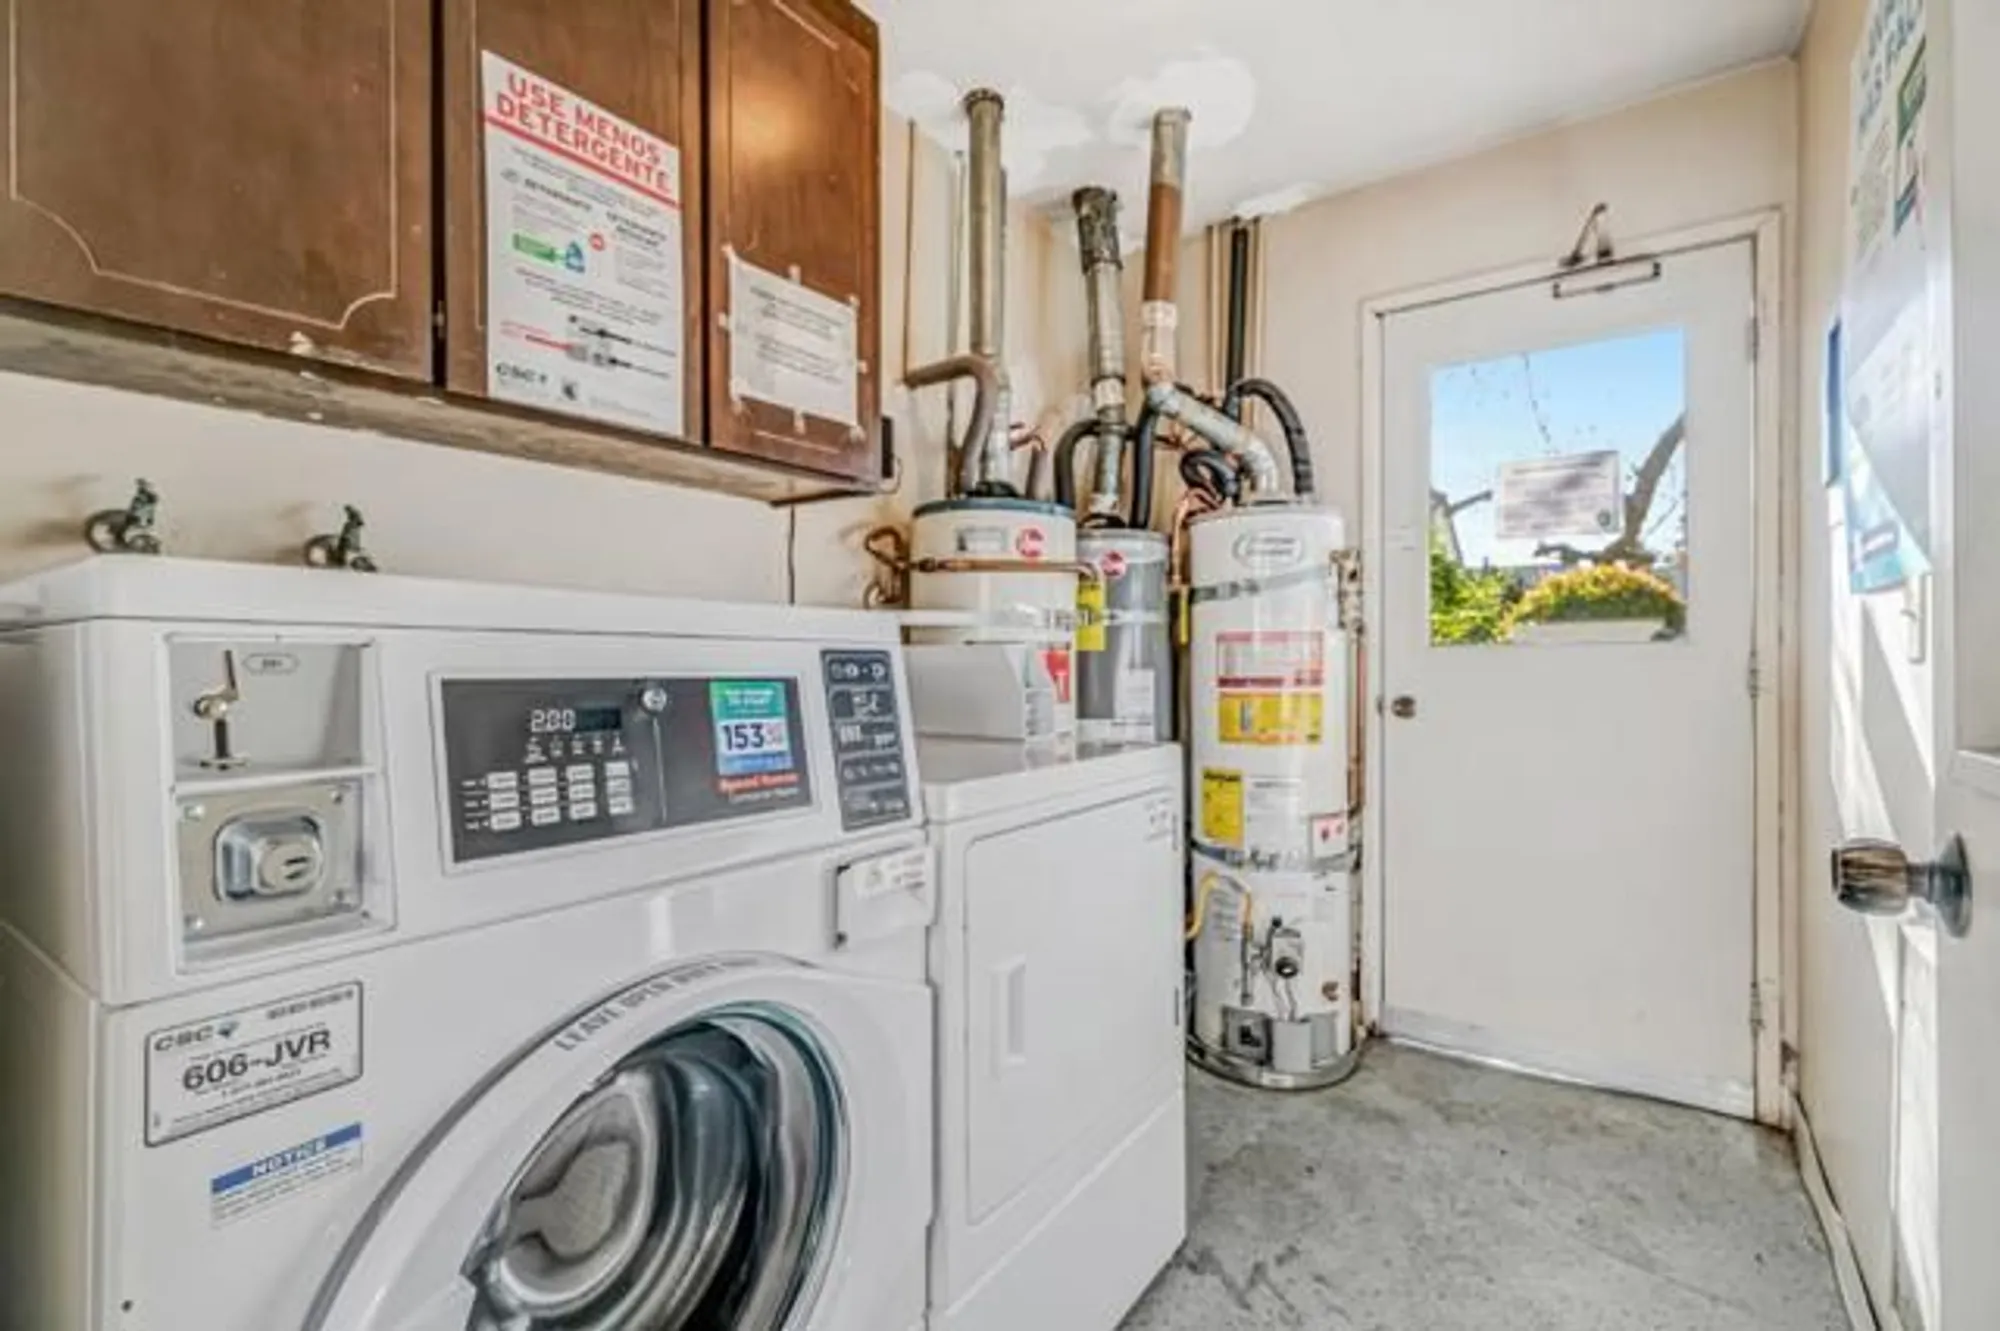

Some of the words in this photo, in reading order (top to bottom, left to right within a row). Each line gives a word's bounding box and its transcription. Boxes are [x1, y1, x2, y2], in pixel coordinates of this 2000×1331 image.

[497, 92, 671, 194] DETERGENTE
[508, 72, 565, 119] USE
[575, 105, 661, 165] MENOS
[723, 721, 765, 751] 153
[154, 1024, 215, 1052] CSC
[183, 1029, 331, 1091] 606-JVR
[252, 1136, 328, 1178] NOTICE
